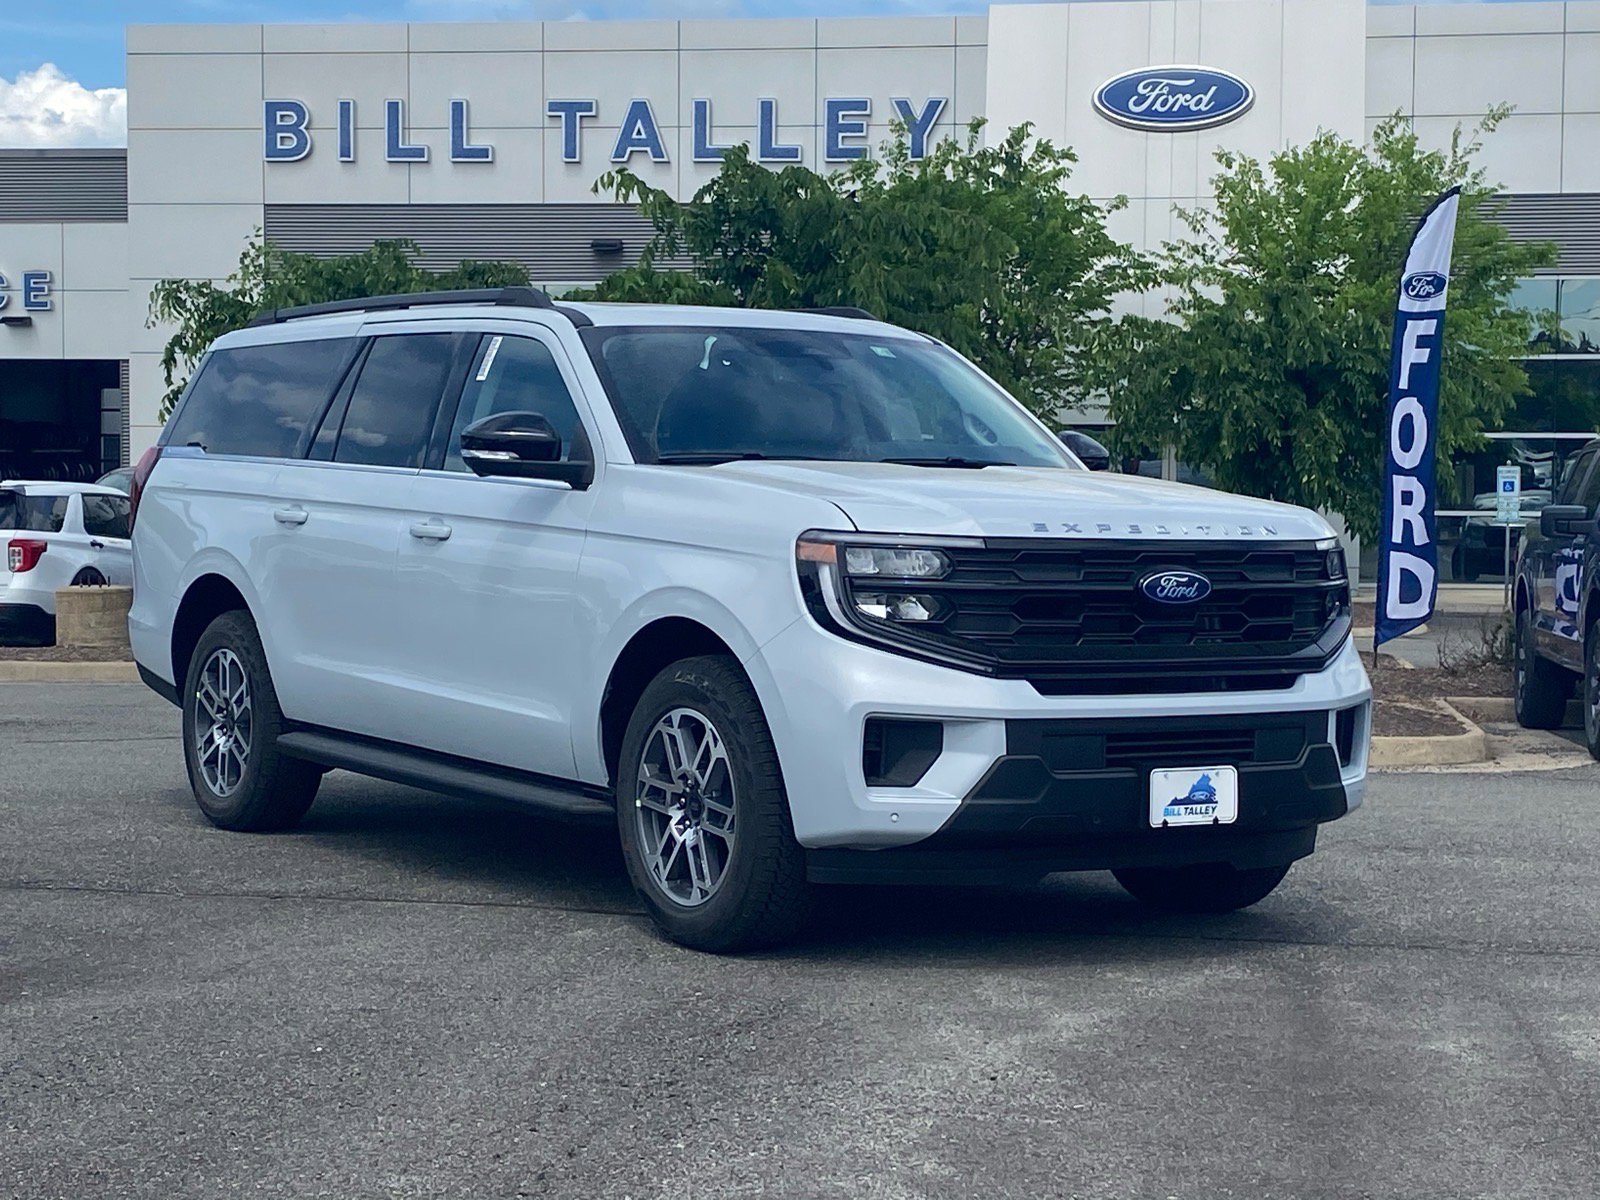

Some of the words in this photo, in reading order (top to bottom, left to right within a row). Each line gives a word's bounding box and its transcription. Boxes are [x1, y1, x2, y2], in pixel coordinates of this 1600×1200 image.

[1127, 78, 1218, 113] Ford
[264, 99, 493, 163] BILL
[547, 98, 948, 164] TALLEY
[0, 269, 52, 311] E
[1386, 318, 1438, 620] FORD
[1032, 522, 1279, 536] EXPEDITION
[1156, 576, 1199, 598] Ford
[1163, 806, 1182, 817] BILL
[1183, 805, 1218, 816] TALLEY
